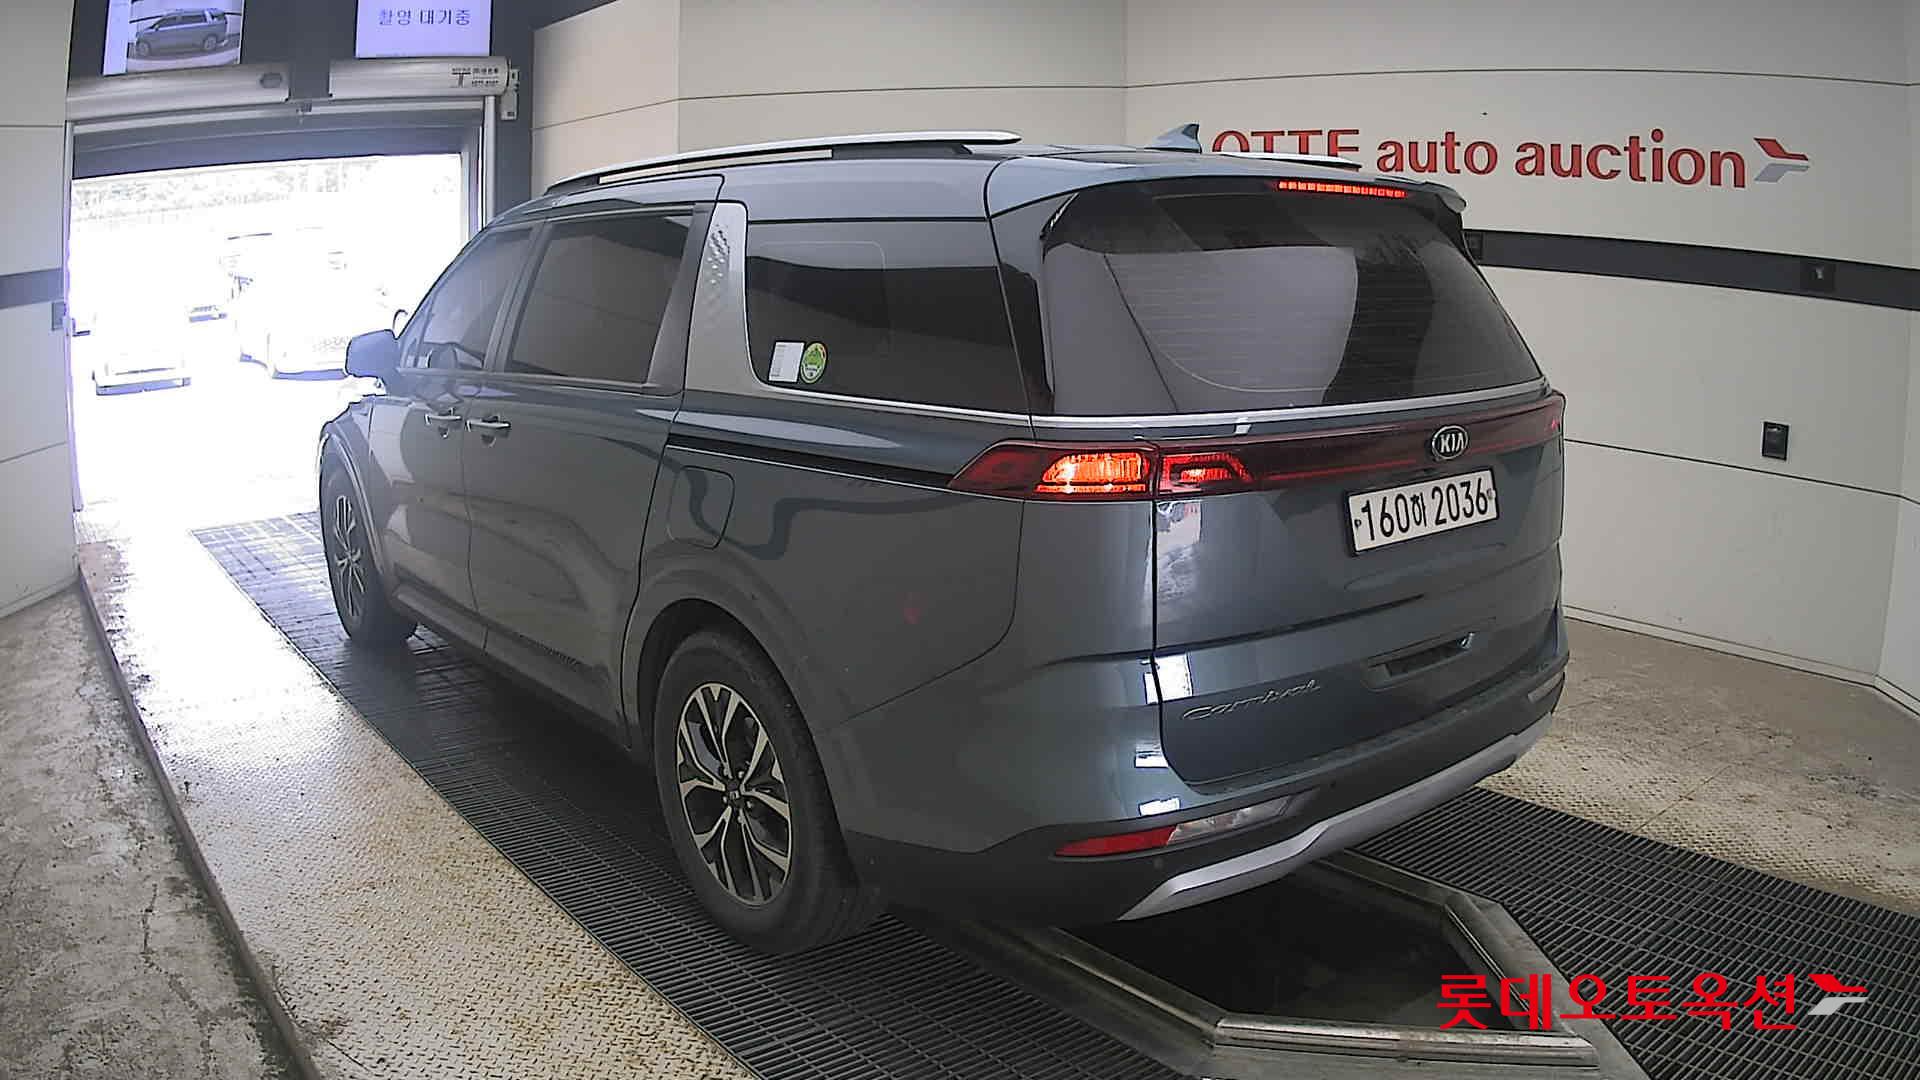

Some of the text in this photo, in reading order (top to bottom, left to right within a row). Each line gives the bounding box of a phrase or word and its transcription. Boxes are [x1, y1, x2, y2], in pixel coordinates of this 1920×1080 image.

[419, 8, 471, 26] 대기중
[1211, 128, 1746, 189] OTTE auto auction
[1361, 477, 1489, 541] 160하 2036
